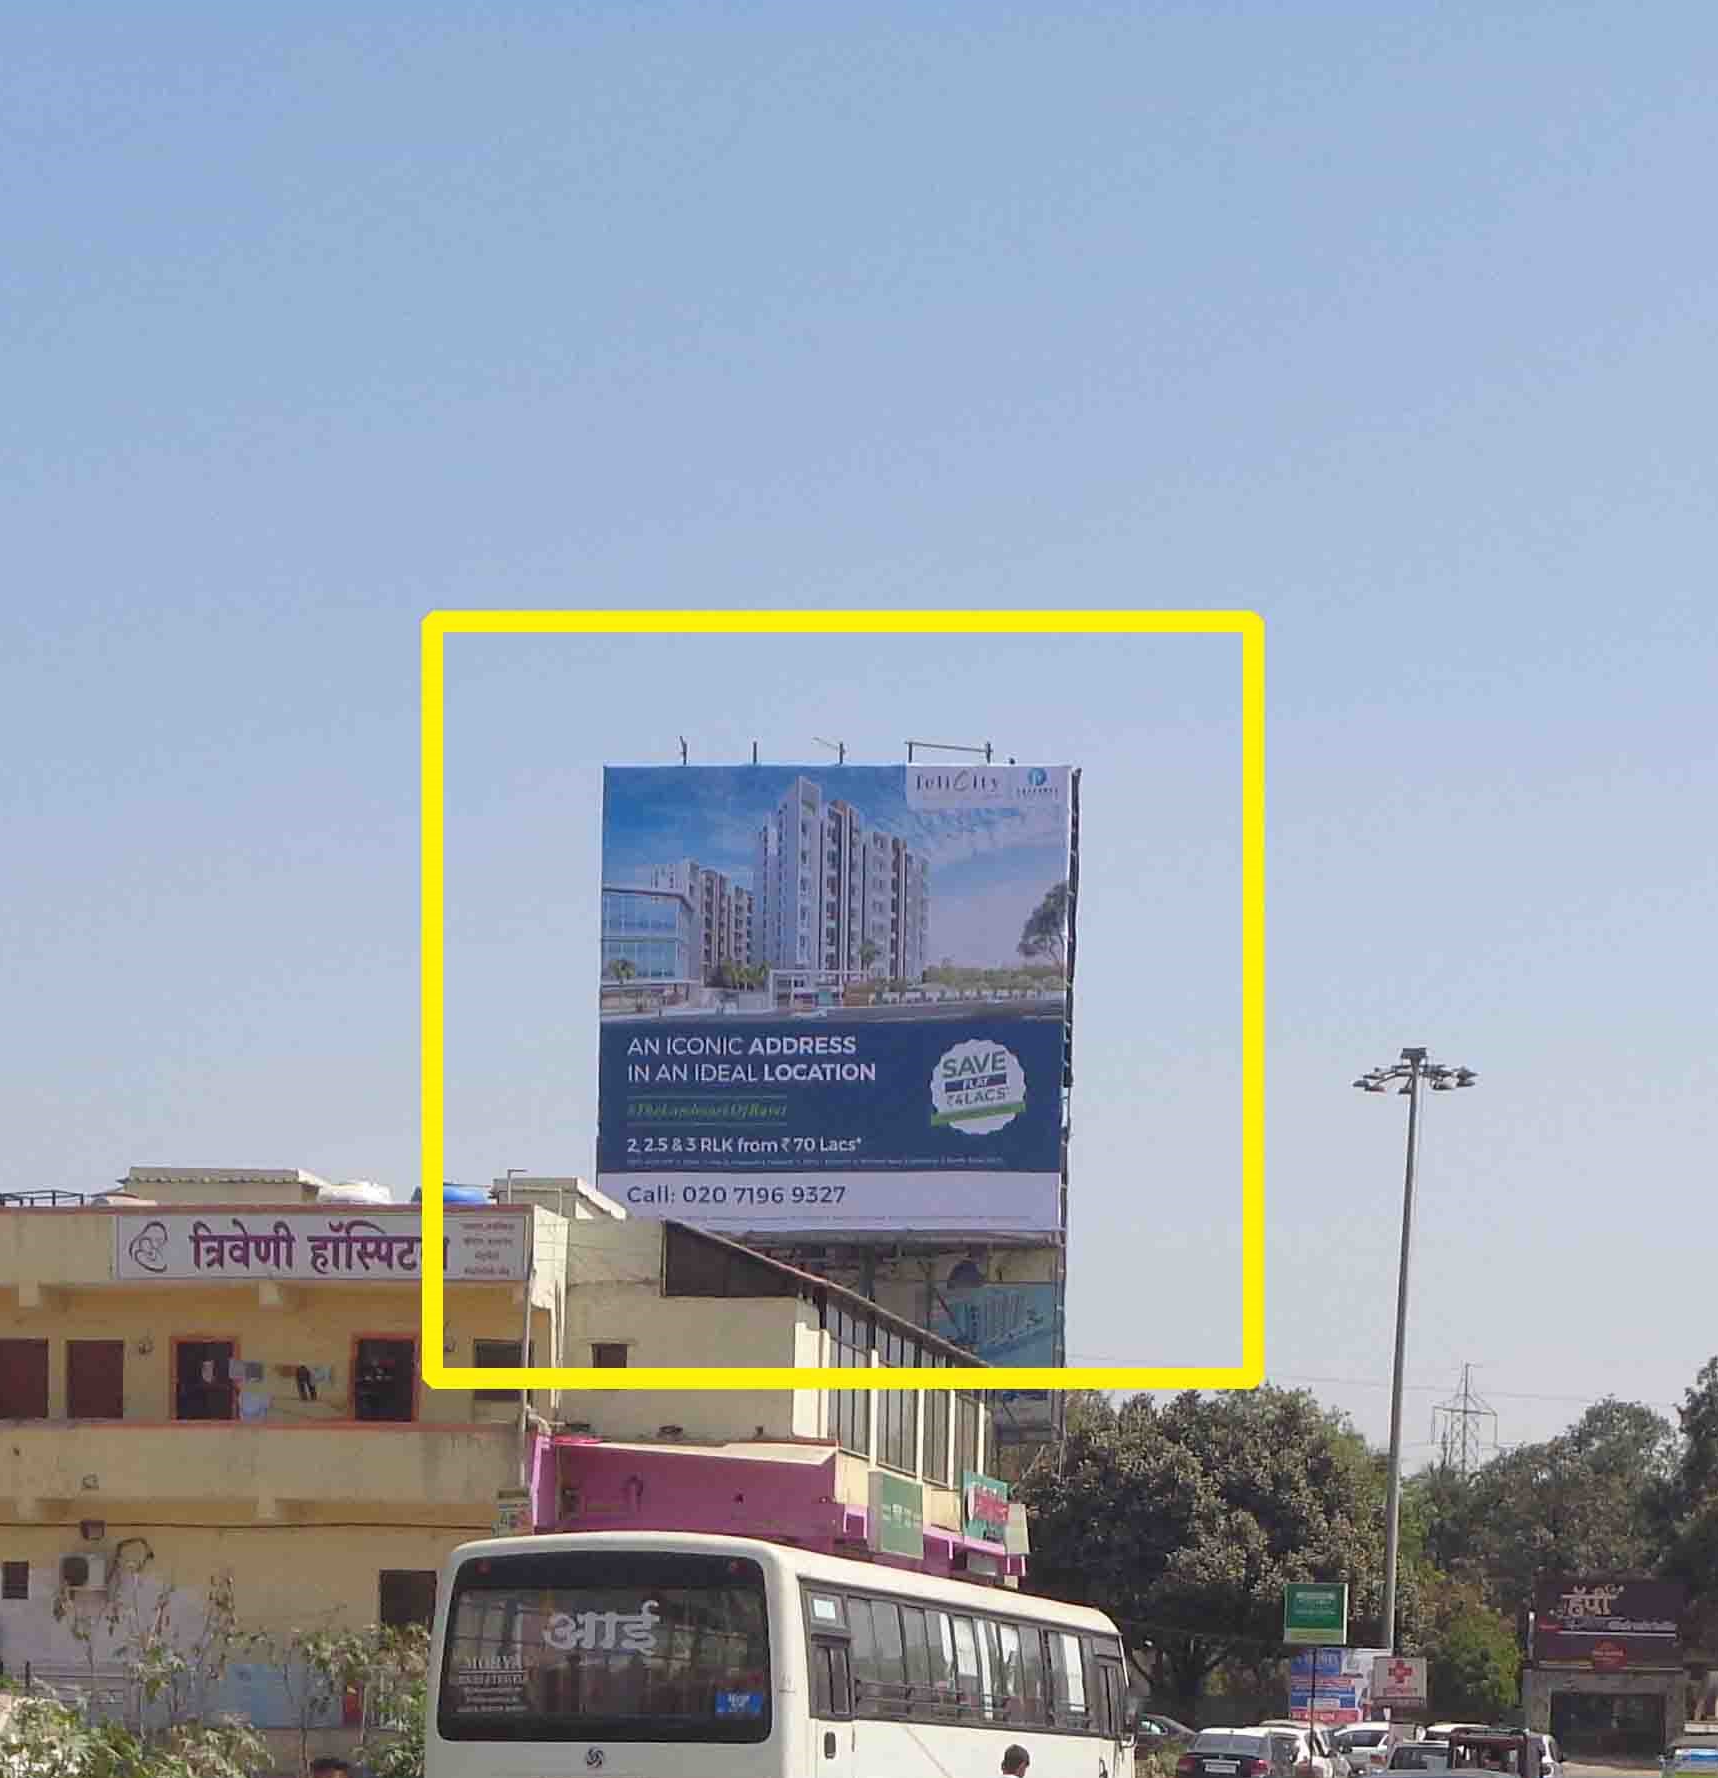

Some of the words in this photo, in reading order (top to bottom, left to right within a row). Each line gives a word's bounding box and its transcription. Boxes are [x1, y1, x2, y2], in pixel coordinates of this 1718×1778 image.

[627, 1037, 659, 1055] AN
[667, 1037, 744, 1055] ICONIC
[748, 1036, 857, 1055] ADDRESS
[628, 1064, 650, 1081] IN
[655, 1064, 687, 1081] AN
[695, 1064, 758, 1081] IDEAL
[764, 1063, 876, 1081] LOCATION
[942, 1050, 1006, 1078] SAVE
[644, 1138, 668, 1152] 2.5
[672, 1138, 682, 1152] &
[685, 1138, 697, 1152] 3
[738, 1137, 778, 1152] from
[627, 1185, 675, 1204] Call:
[682, 1186, 727, 1203] 020
[734, 1187, 784, 1204] 7196
[791, 1186, 845, 1203] 9327
[189, 1218, 295, 1270] त्रिवेणी
[543, 1600, 660, 1656] आई
